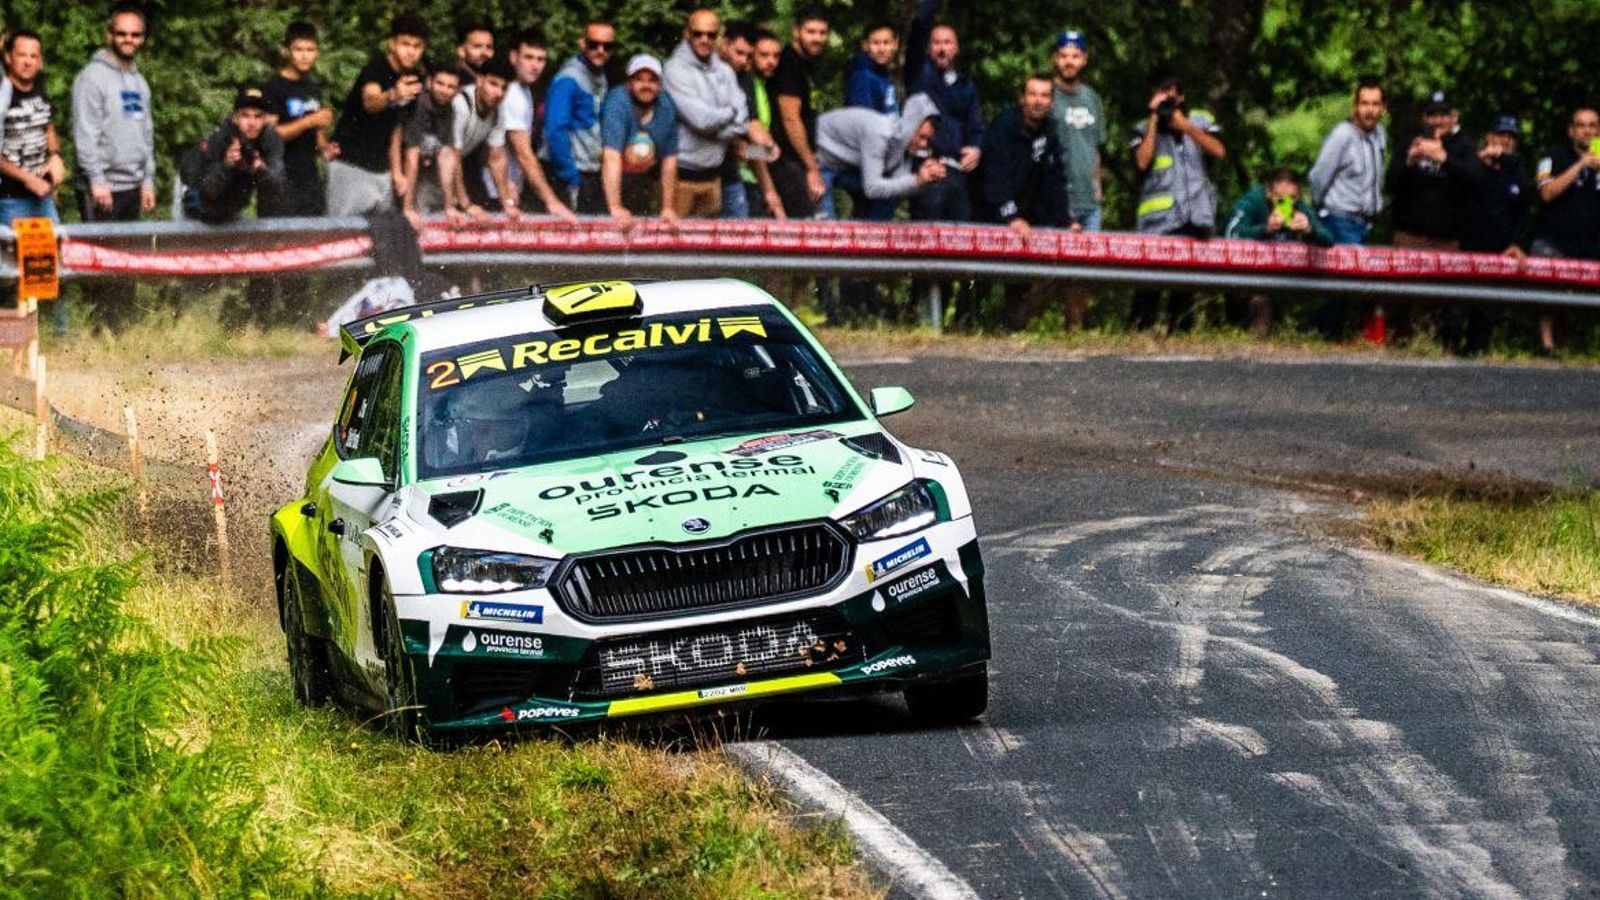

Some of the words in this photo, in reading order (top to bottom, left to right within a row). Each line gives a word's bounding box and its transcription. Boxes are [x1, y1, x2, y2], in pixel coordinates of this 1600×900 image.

[512, 319, 711, 369] Recalvi
[426, 361, 460, 390] 2
[538, 455, 804, 500] ourense
[575, 472, 711, 505] provincia
[723, 466, 816, 479] termal
[886, 543, 925, 568] MICHELIN
[888, 568, 936, 597] ourense
[482, 607, 536, 619] MICHELIN
[480, 633, 543, 649] ourense
